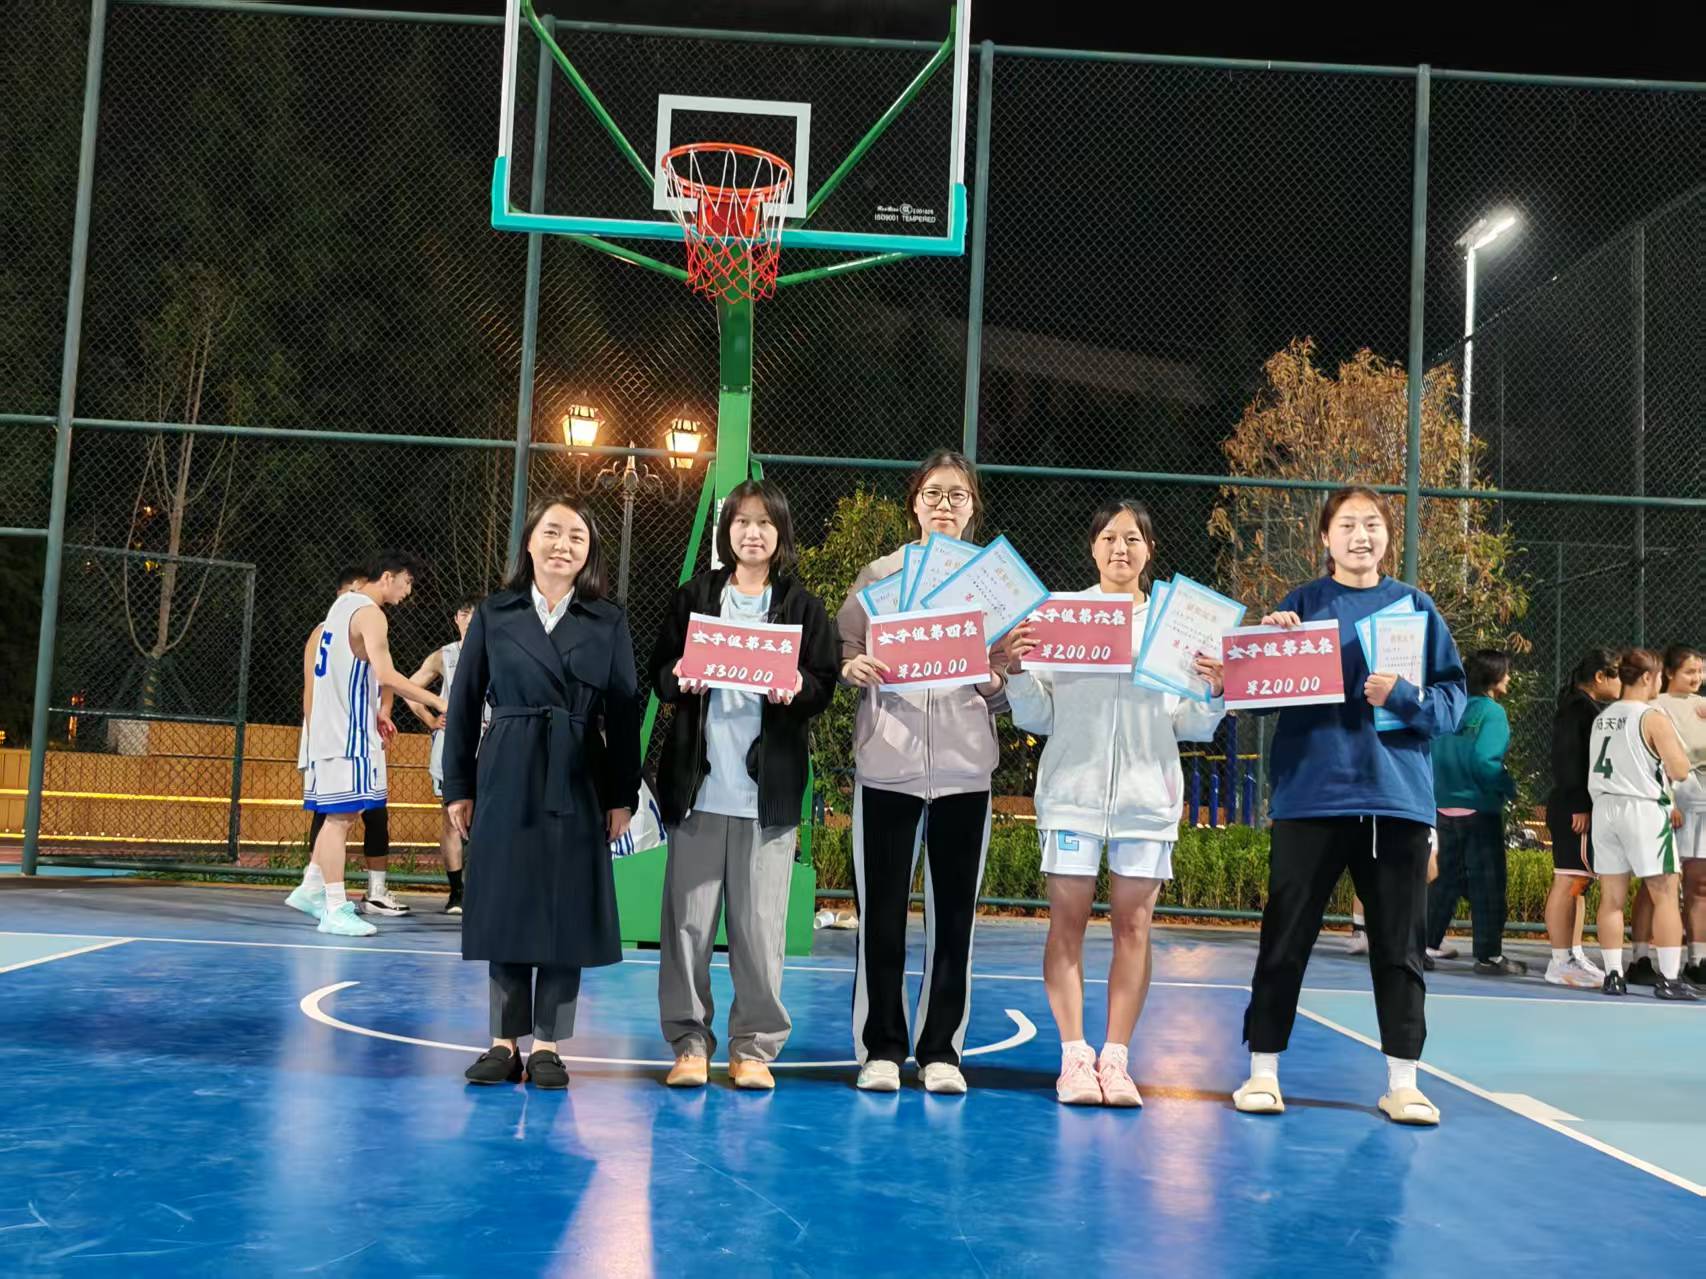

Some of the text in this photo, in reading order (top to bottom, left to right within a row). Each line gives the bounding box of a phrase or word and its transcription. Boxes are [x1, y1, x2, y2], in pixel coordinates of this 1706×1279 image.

[875, 213, 936, 223] ISO9001 TEMPERED
[1026, 608, 1126, 626] 女子组第六名
[692, 630, 793, 654] 女子组第三名
[878, 620, 978, 645] 女子组第四名
[314, 630, 333, 677] 5
[1040, 643, 1111, 660] ¥200.00
[1227, 637, 1334, 660] 女子组第五名
[703, 664, 774, 683] ¥300.00
[897, 658, 968, 679] ¥200.00
[1245, 676, 1321, 695] ¥200.00
[1593, 735, 1613, 778] 4
